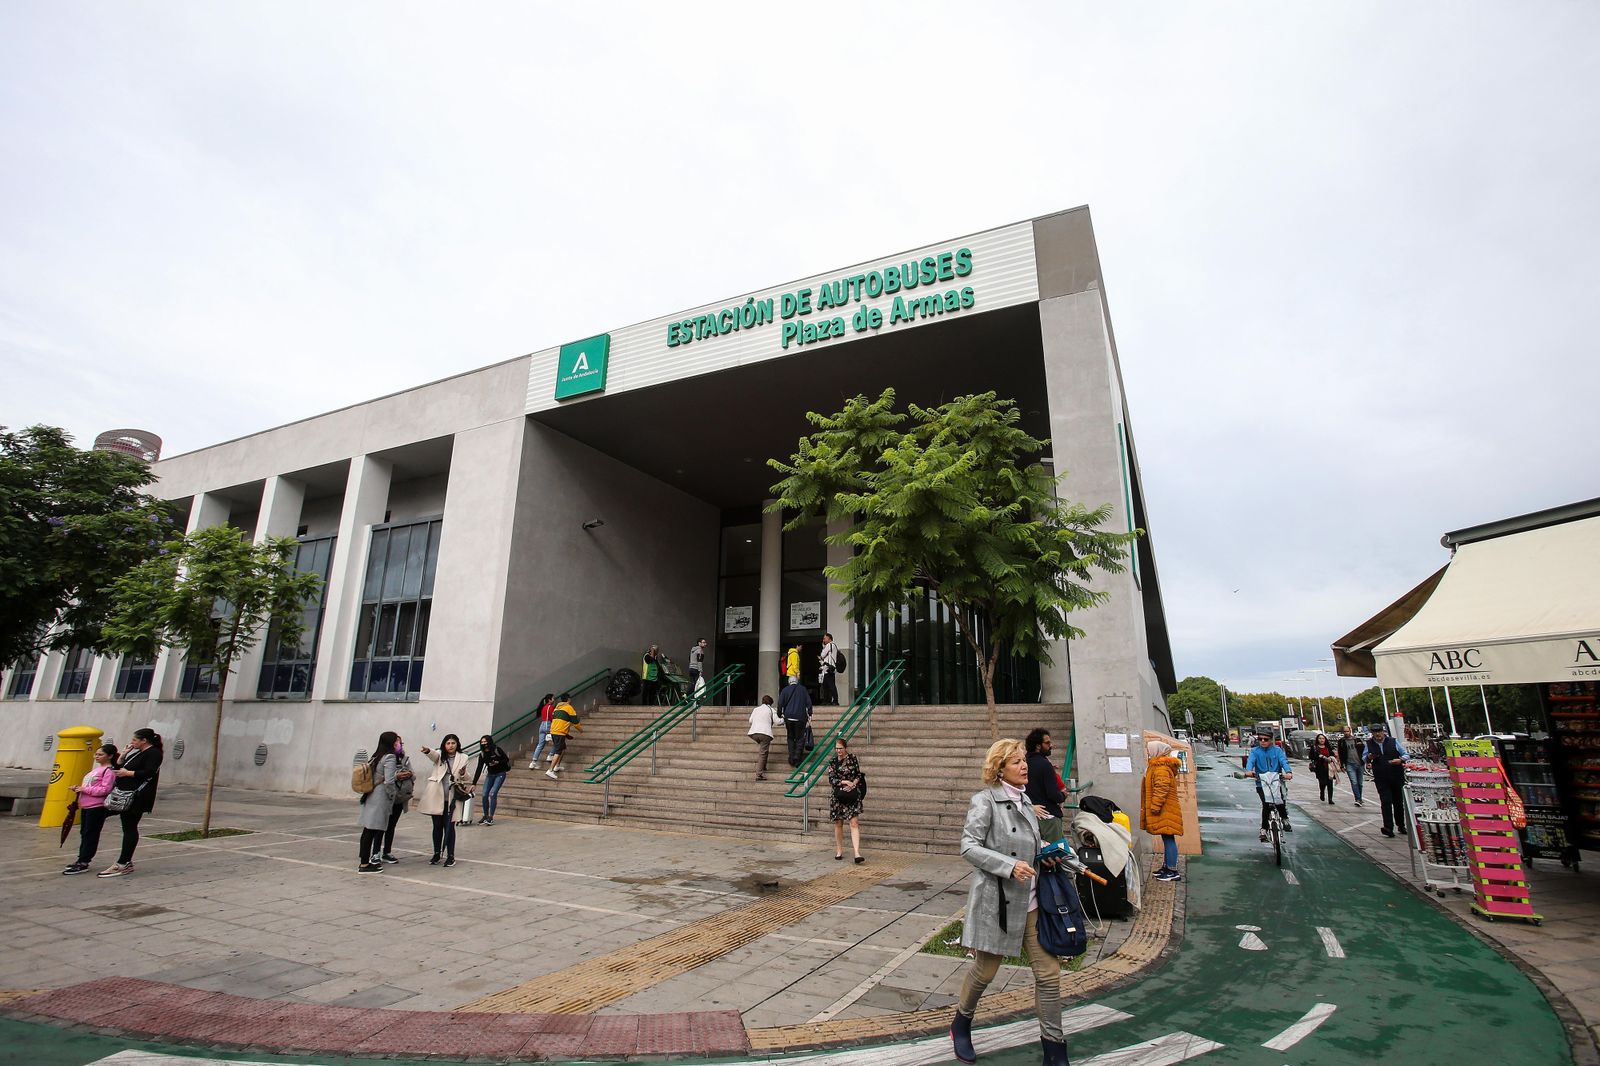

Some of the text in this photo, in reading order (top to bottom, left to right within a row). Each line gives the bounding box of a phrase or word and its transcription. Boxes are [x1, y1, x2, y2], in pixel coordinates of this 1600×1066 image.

[667, 248, 972, 347] ESTACIÓN DE AUTOBUSES
[781, 286, 974, 349] Plaza de Armas
[1429, 649, 1483, 671] ABC
[1428, 674, 1491, 682] abcdesevilla.es
[1572, 668, 1600, 676] abcd
